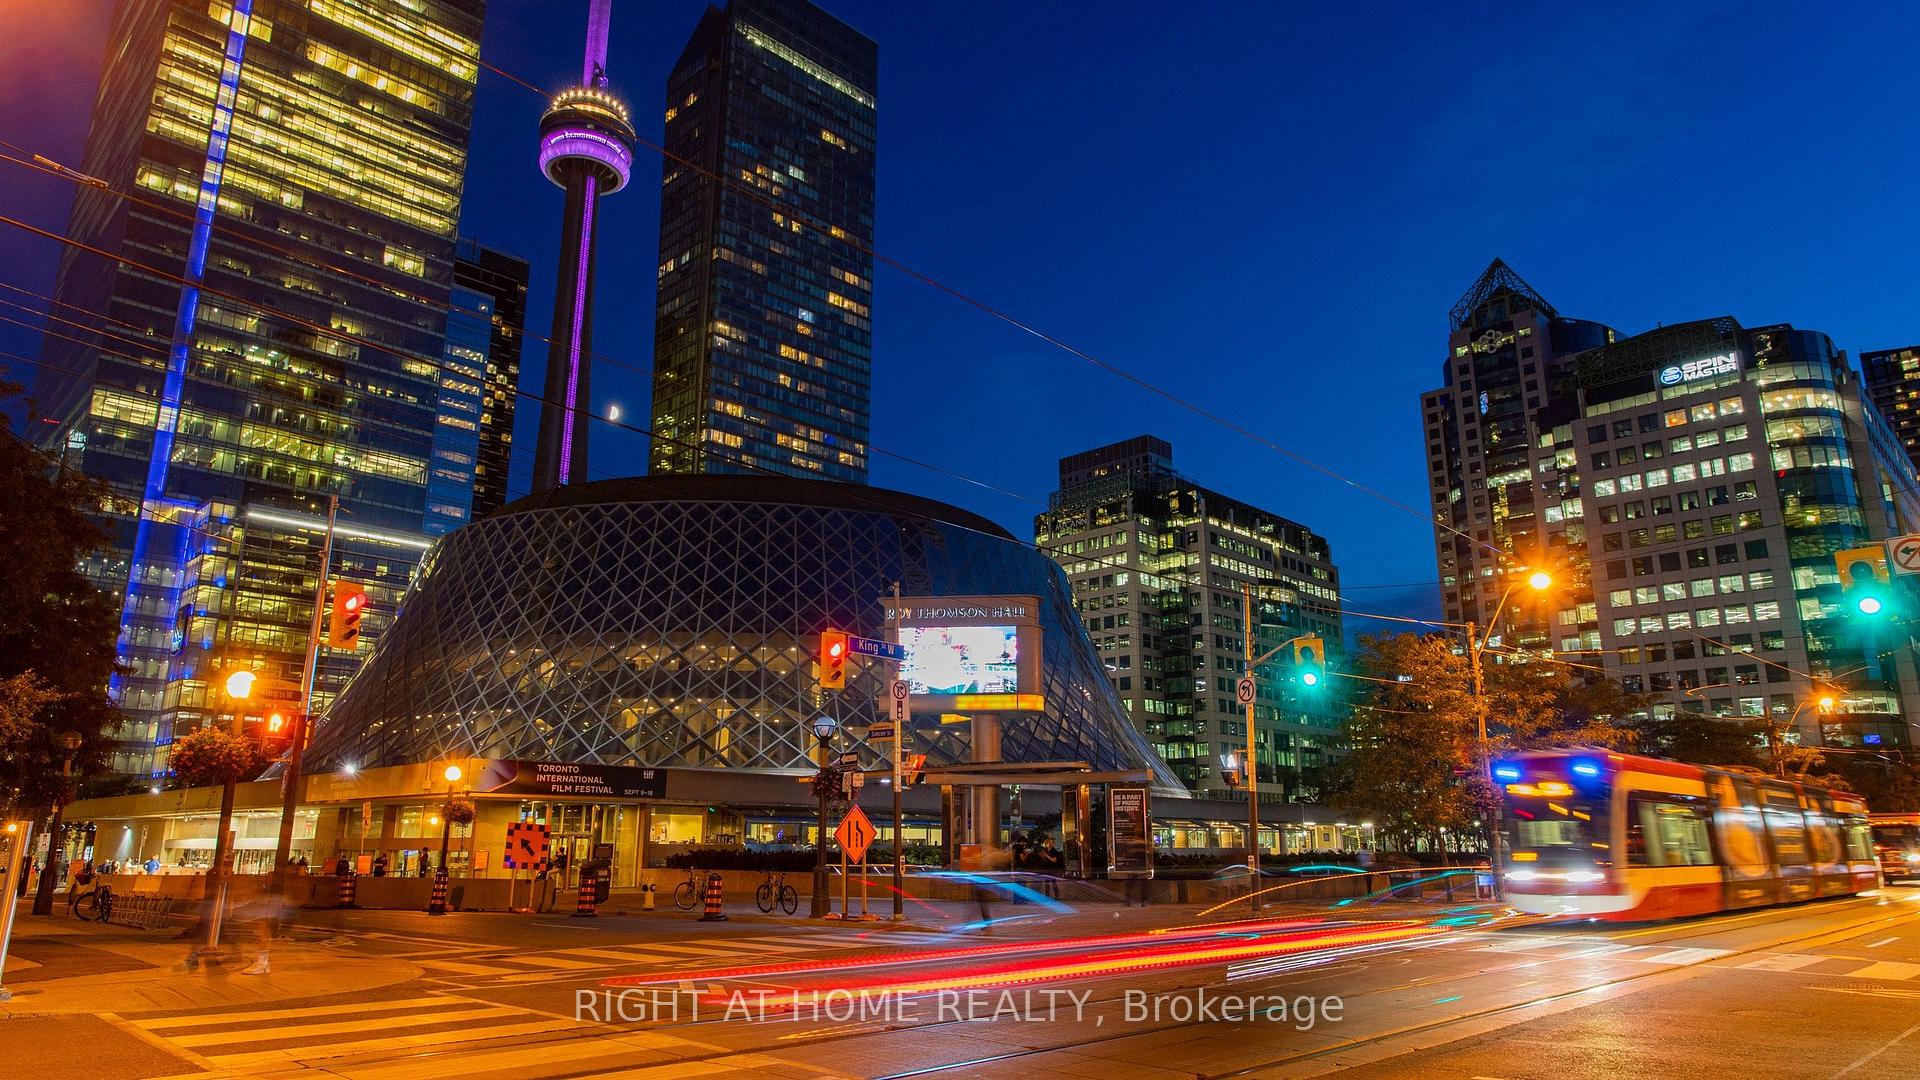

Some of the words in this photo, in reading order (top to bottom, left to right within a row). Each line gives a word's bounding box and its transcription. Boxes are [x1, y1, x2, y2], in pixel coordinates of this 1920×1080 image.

[1681, 353, 1736, 373] SPIN
[1683, 362, 1737, 381] MASTER
[917, 607, 988, 619] THOMSON
[992, 606, 1025, 618] HALL
[858, 639, 879, 655] King
[887, 644, 895, 655] W
[537, 764, 580, 774] TORONTO
[536, 774, 604, 784] INTERNATIONAL
[643, 770, 655, 779] tiff
[551, 784, 572, 793] FILM
[574, 785, 614, 794] FESTIVAL
[624, 788, 639, 796] SEPT
